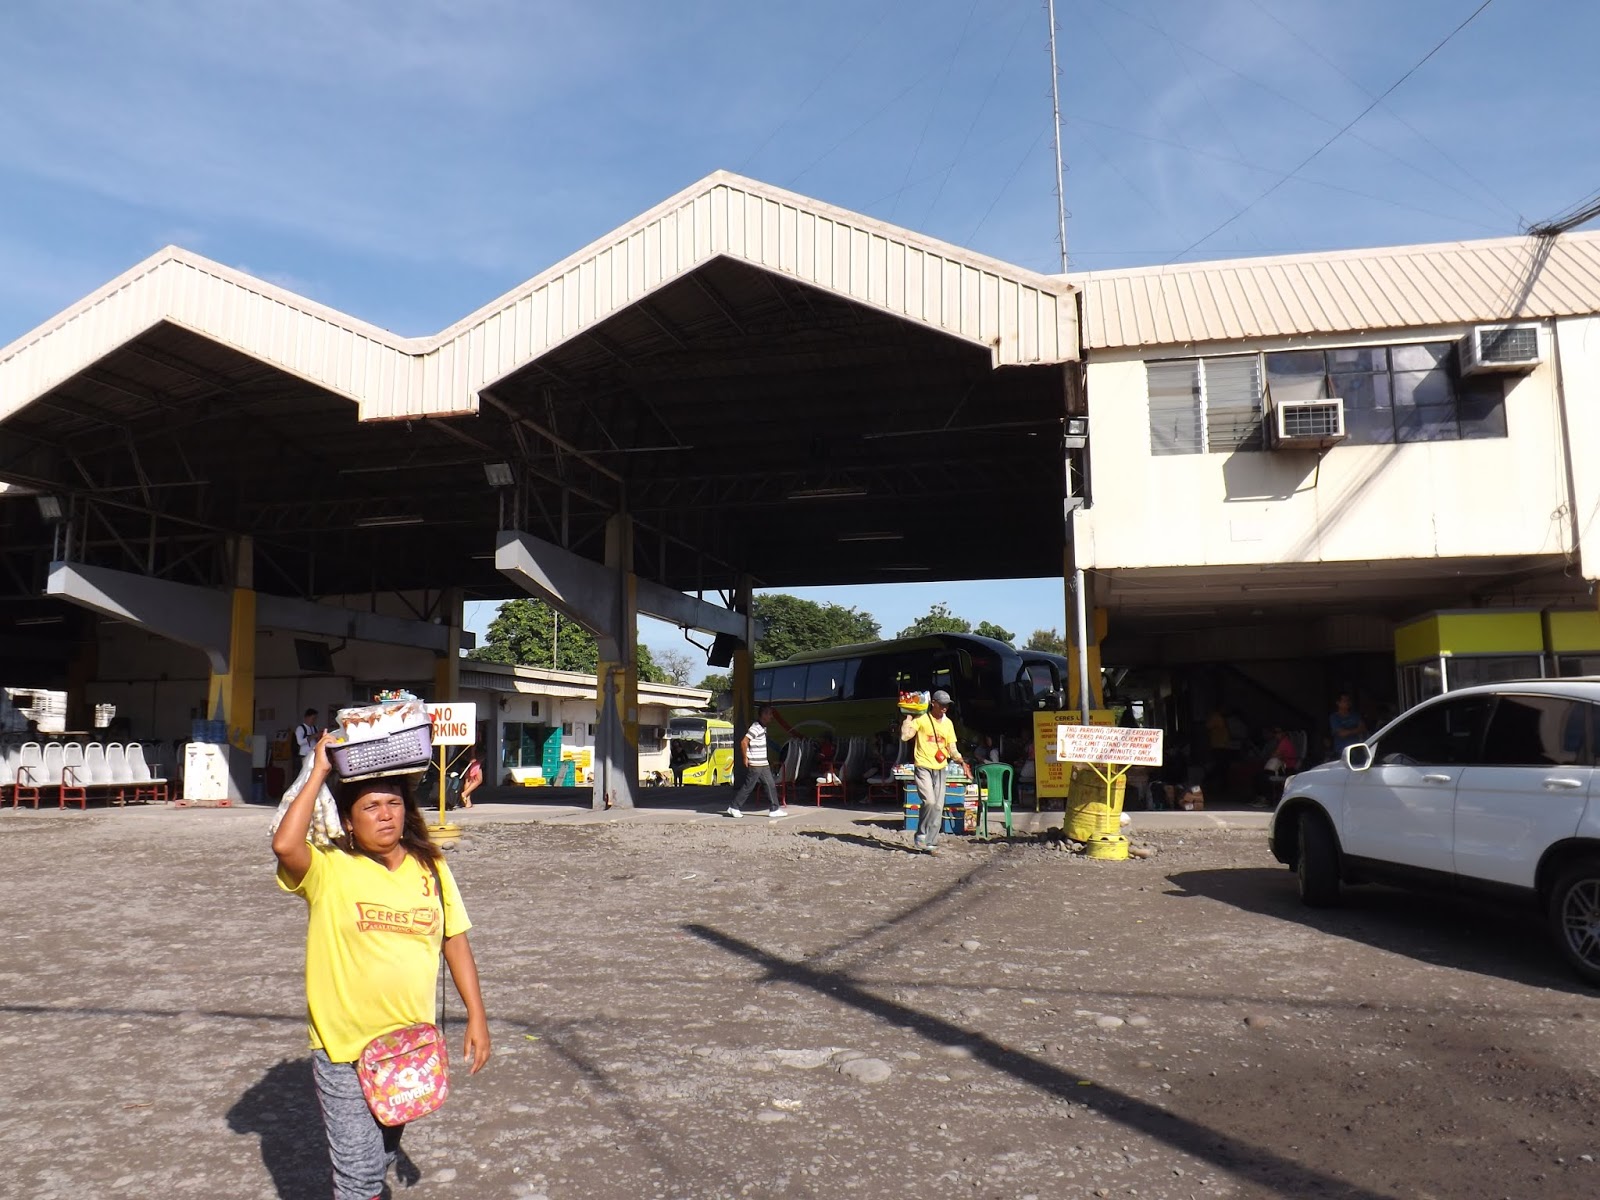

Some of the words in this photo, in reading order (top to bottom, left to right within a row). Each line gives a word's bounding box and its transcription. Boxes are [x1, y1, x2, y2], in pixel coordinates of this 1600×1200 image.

[435, 707, 452, 721] NO
[433, 722, 467, 737] RKING
[1106, 727, 1125, 735] SPACE
[365, 909, 409, 924] CERES
